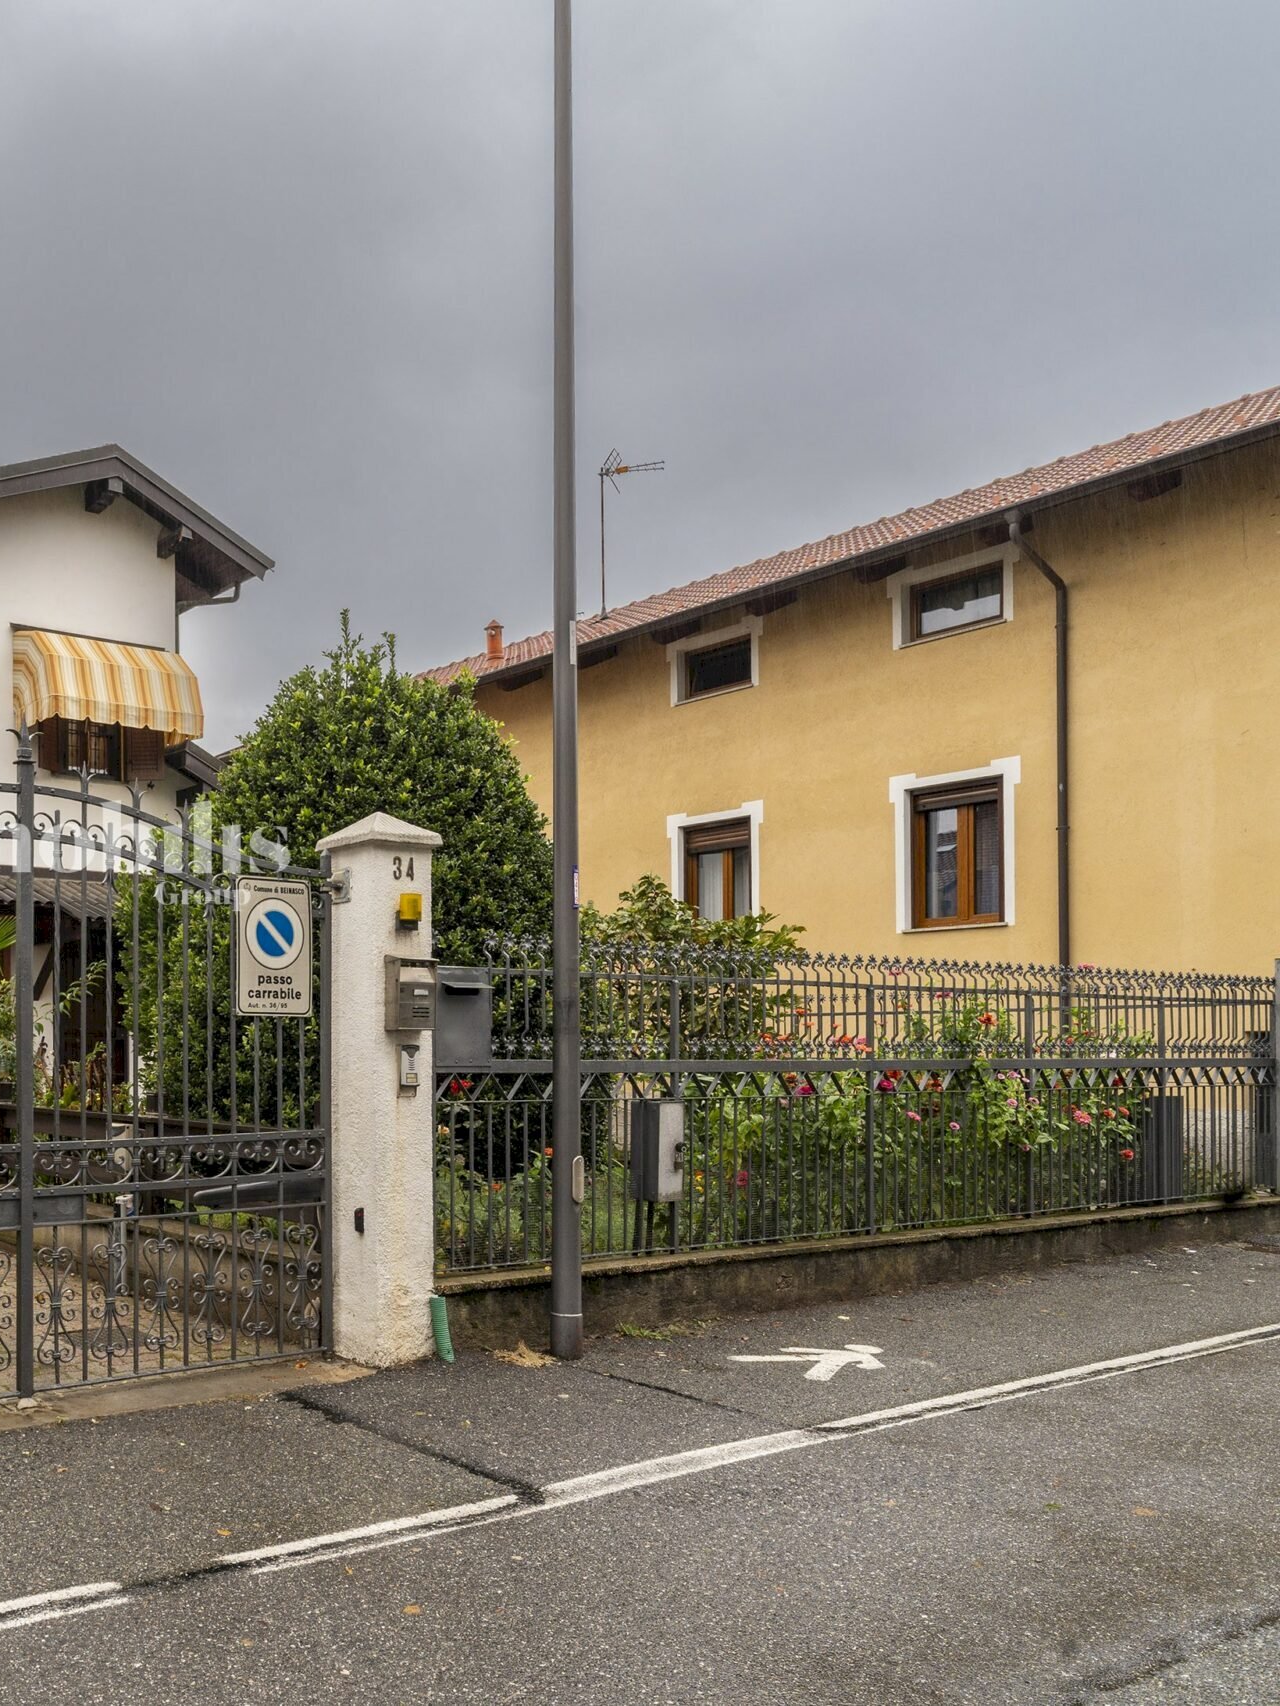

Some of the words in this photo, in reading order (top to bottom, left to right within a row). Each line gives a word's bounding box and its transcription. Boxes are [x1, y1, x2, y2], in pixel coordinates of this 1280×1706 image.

[392, 856, 414, 881] 34
[254, 885, 273, 893] Comune
[280, 887, 305, 895] BEINASCO
[257, 975, 292, 986] passo
[248, 987, 302, 1000] carrabile
